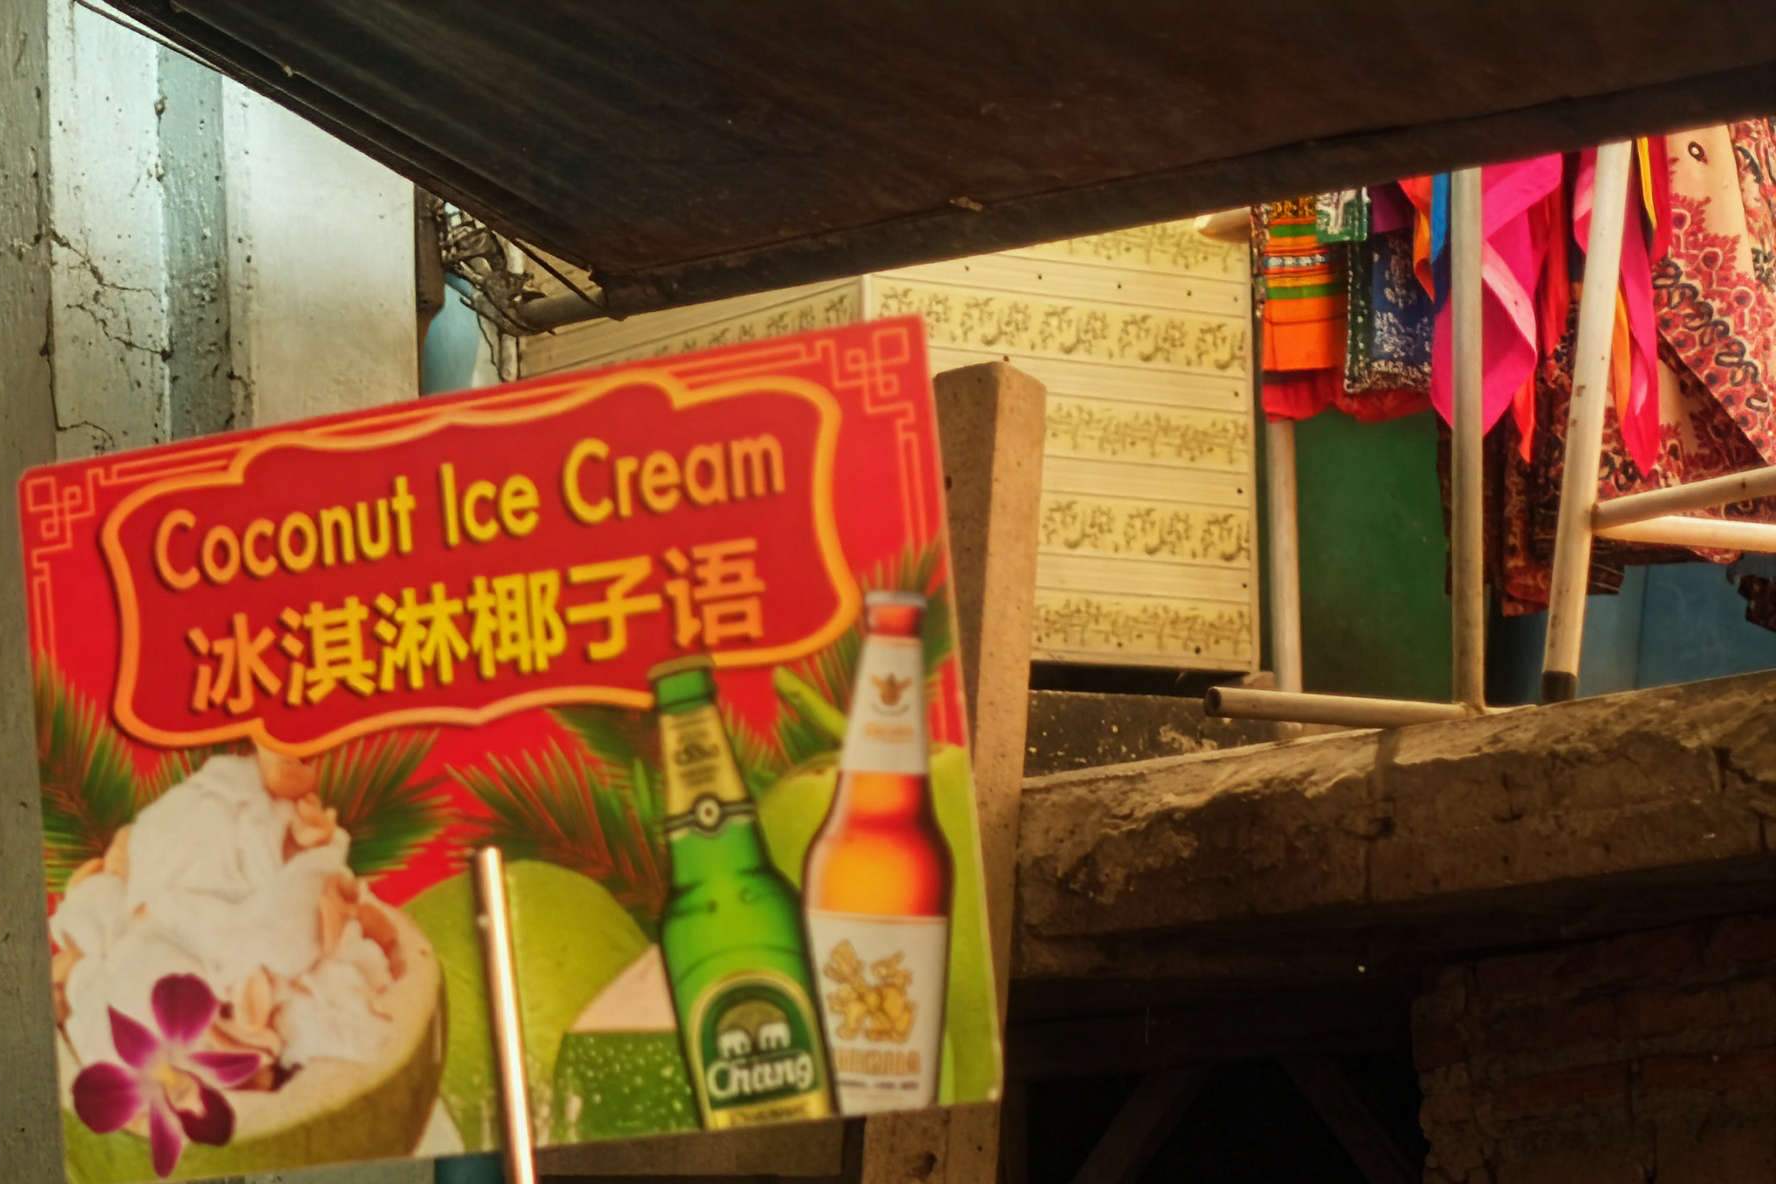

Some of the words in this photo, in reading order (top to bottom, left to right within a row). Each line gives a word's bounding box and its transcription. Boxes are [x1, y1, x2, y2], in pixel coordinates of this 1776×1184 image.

[154, 475, 417, 590] Coconut
[439, 461, 540, 547] Ice
[562, 433, 787, 525] Cream
[187, 537, 765, 716] 冰淇淋椰子语
[706, 1051, 815, 1101] Chang
